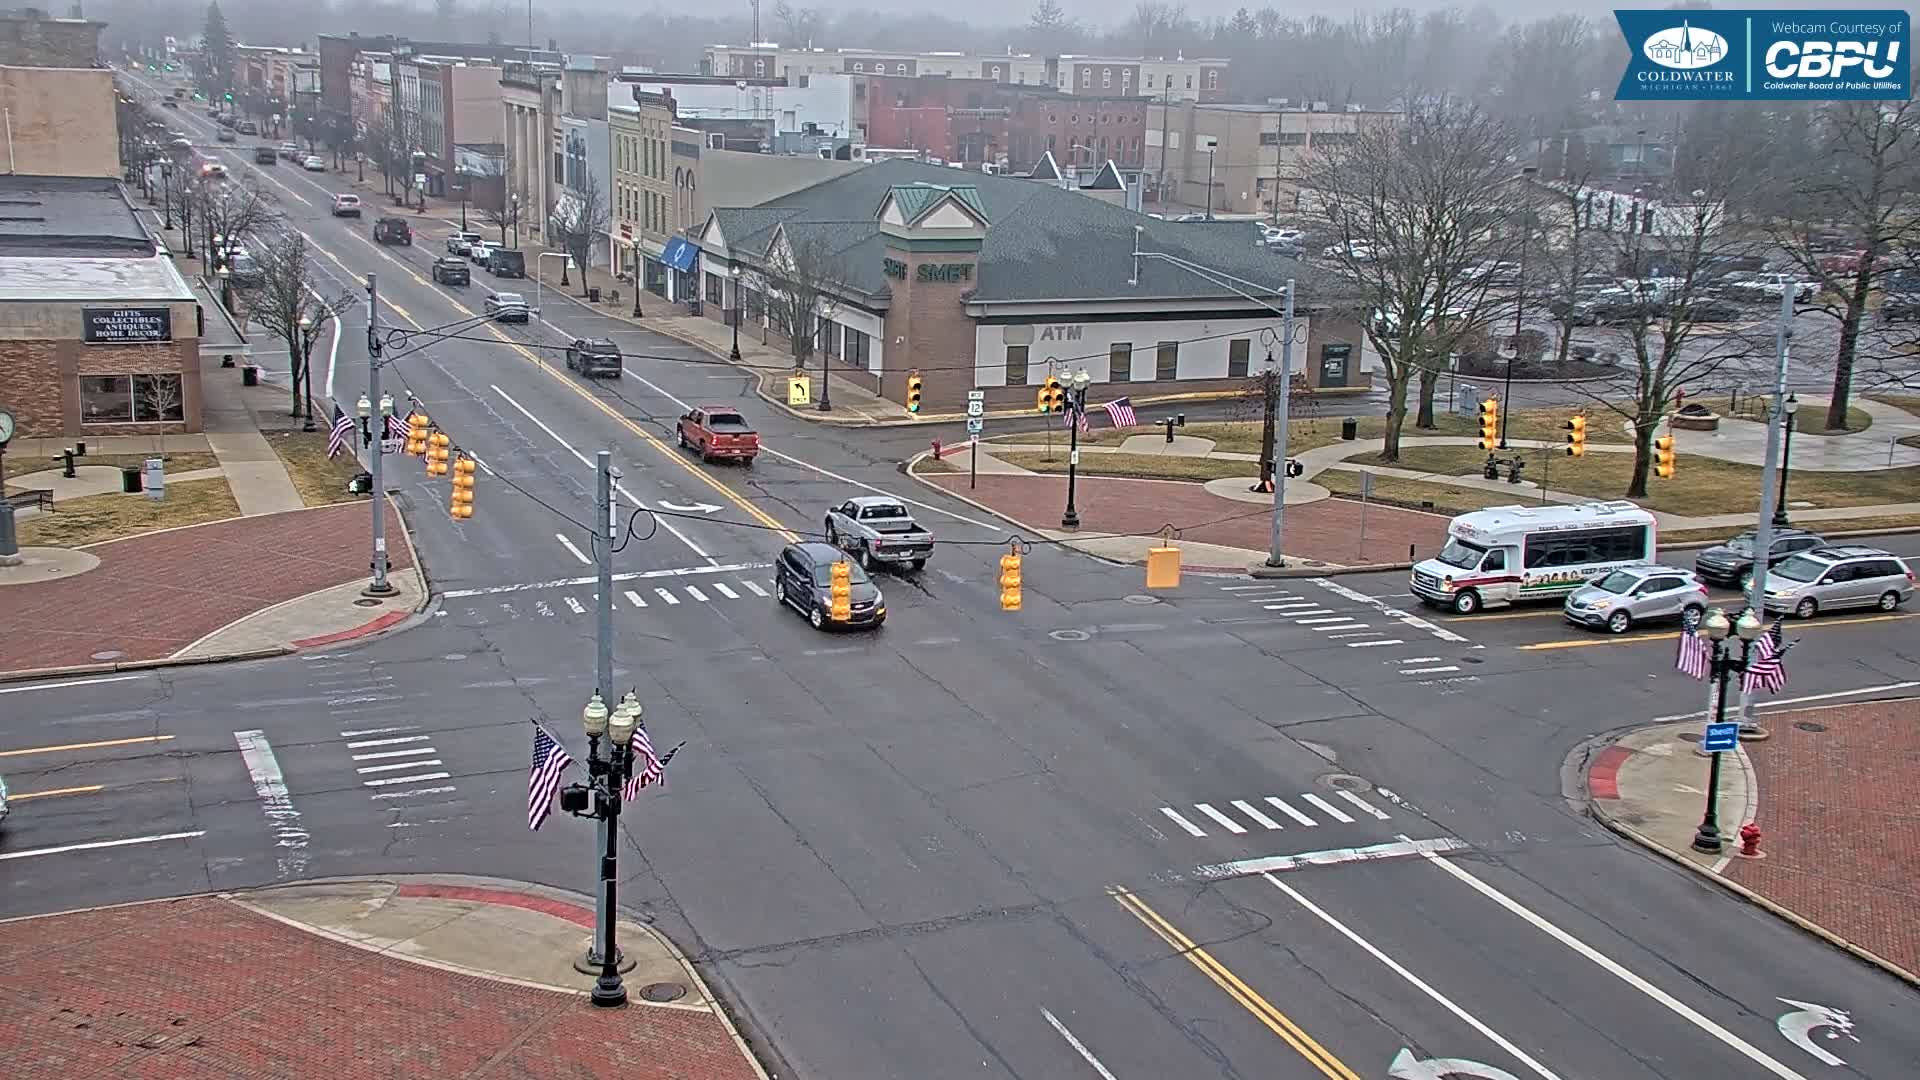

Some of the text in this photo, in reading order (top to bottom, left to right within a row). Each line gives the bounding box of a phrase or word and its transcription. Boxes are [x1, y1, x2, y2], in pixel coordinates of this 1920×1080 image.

[105, 323, 152, 331] ANTIQUES
[1039, 325, 1084, 341] ATM
[971, 403, 981, 413] 12
